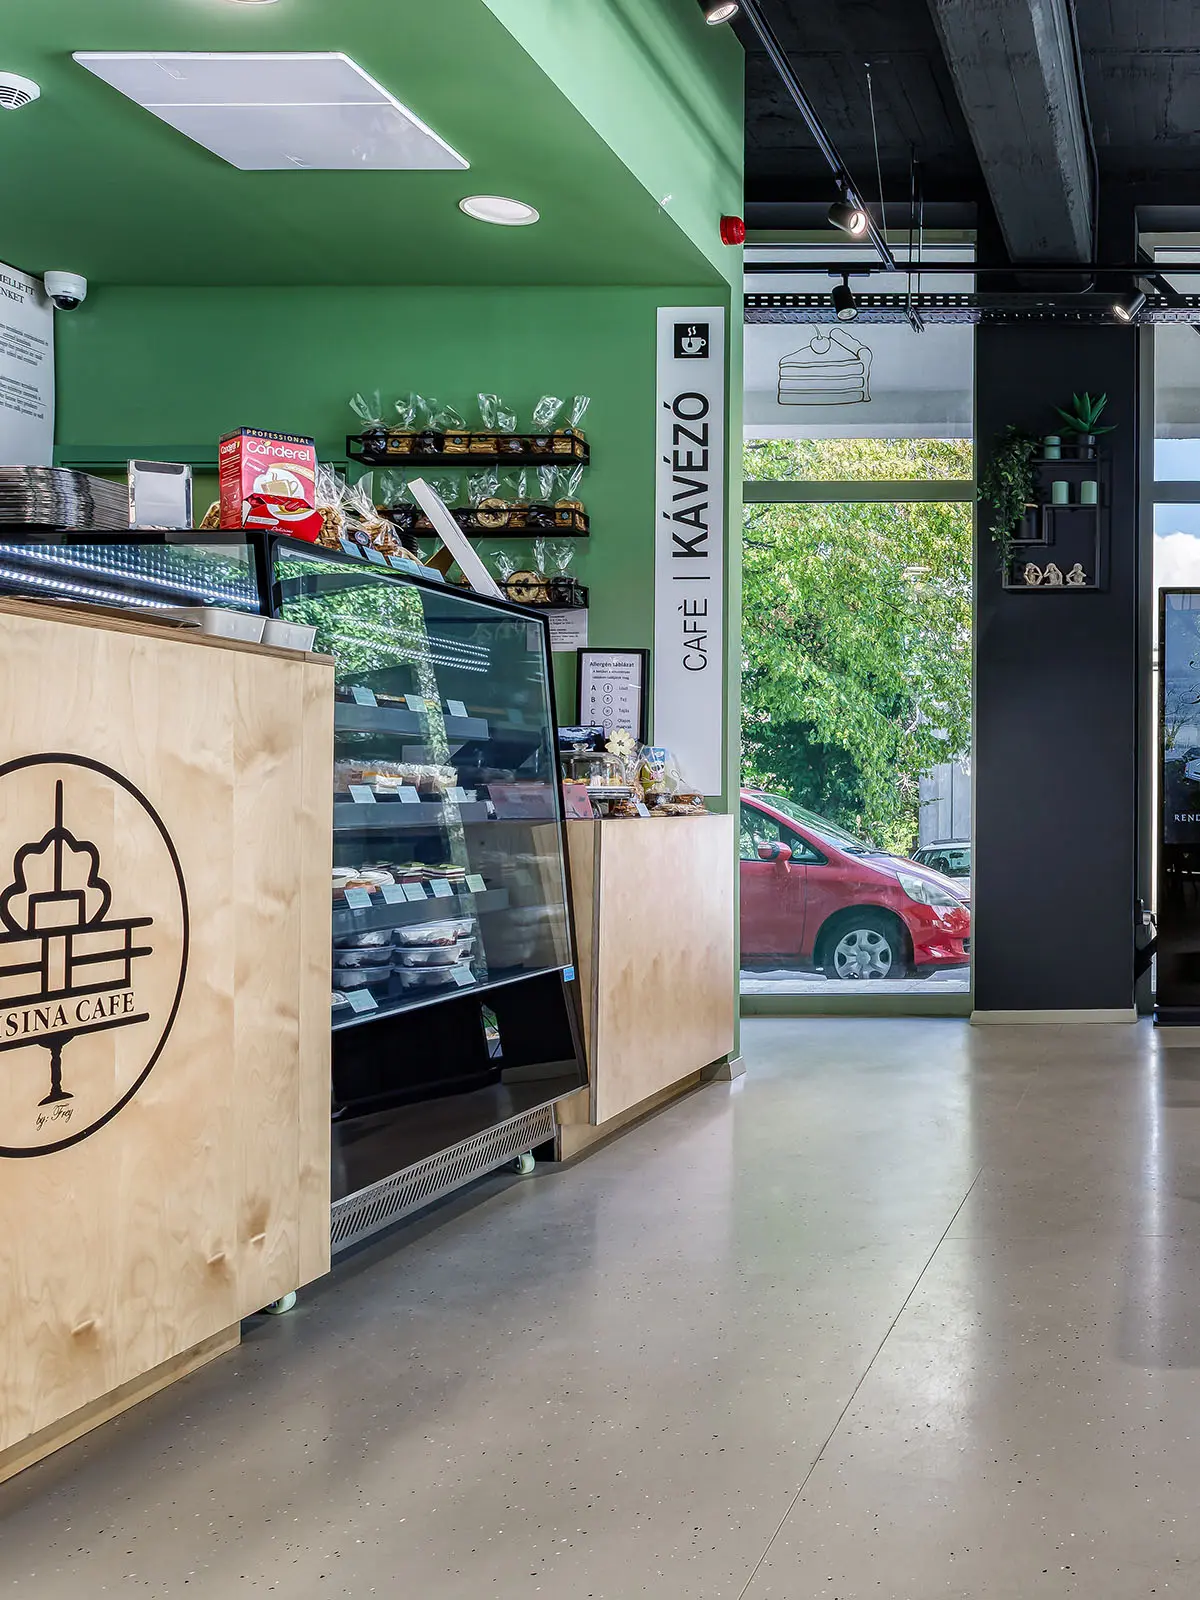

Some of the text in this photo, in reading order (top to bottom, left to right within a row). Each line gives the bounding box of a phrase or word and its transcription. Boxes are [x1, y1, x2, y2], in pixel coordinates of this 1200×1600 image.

[246, 428, 309, 445] PROFESSIONAL
[246, 441, 311, 461] Canderel
[662, 391, 710, 558] KÁVÉZÓ
[0, 991, 135, 1038] SINA CAFE
